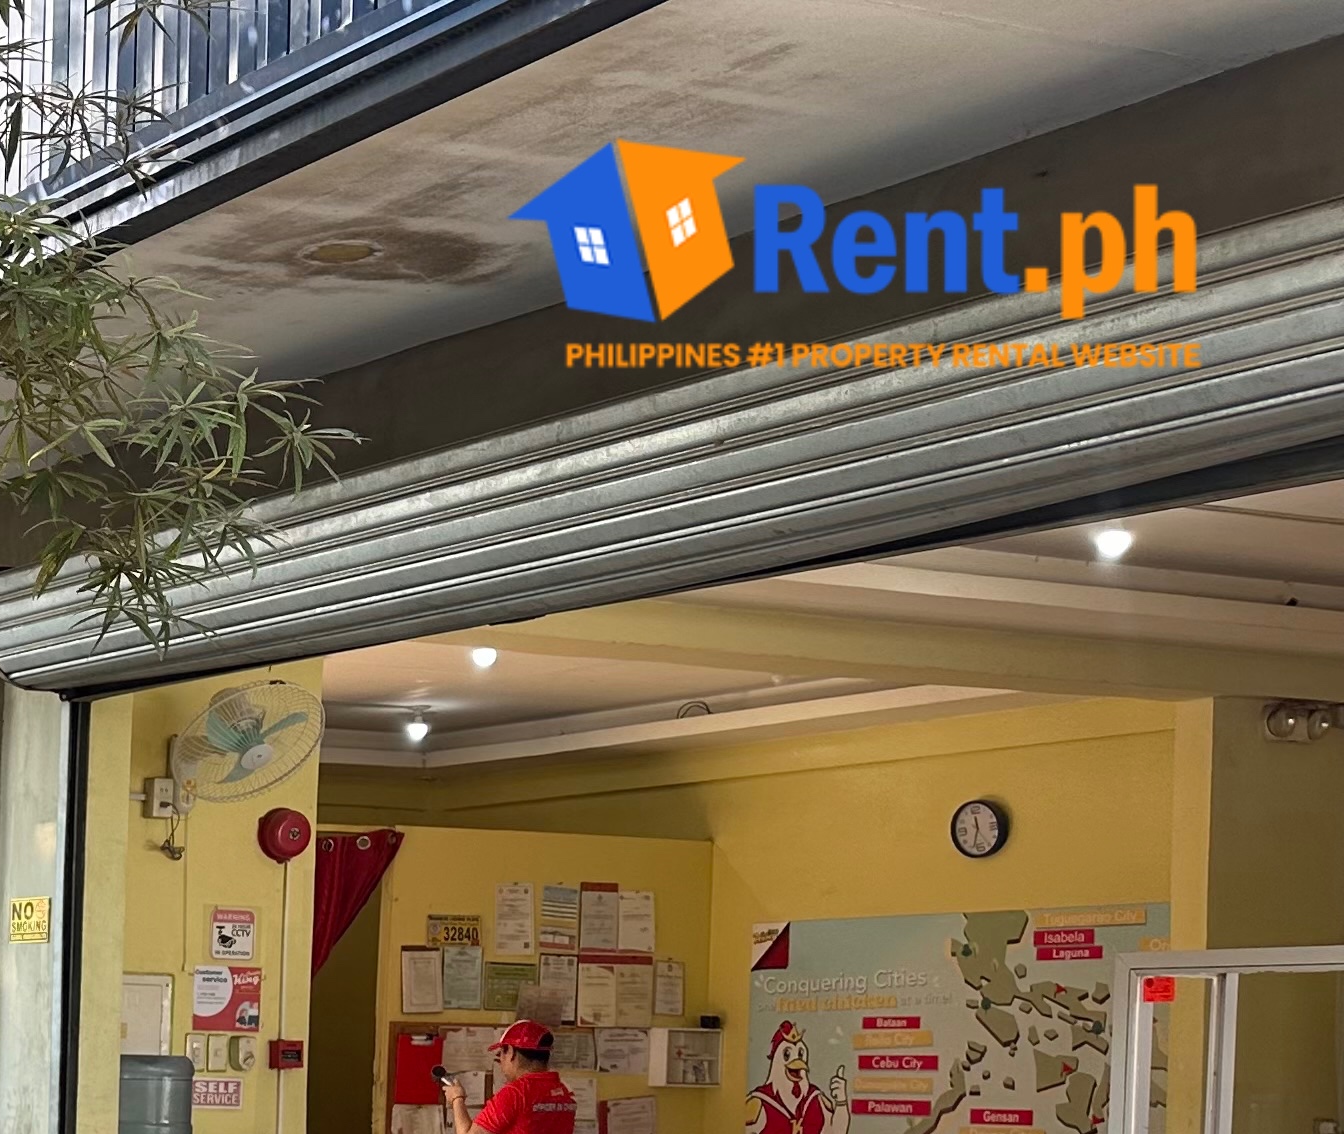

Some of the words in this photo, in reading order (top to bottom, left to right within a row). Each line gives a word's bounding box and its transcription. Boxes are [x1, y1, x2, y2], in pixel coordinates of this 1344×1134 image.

[12, 902, 34, 921] NO
[11, 920, 47, 932] SMOKING
[231, 929, 251, 937] CCTV
[444, 926, 479, 941] 32840
[1044, 931, 1085, 943] Isabela
[1053, 949, 1090, 960] Laguna
[764, 972, 867, 995] Conquering
[874, 969, 928, 988] Cities
[872, 1056, 899, 1068] Cebu
[902, 1056, 923, 1072] City
[194, 1081, 238, 1093] SELF
[193, 1093, 239, 1105] SERVICE
[868, 1101, 913, 1113] Palawan
[983, 1111, 1020, 1122] Gensan
